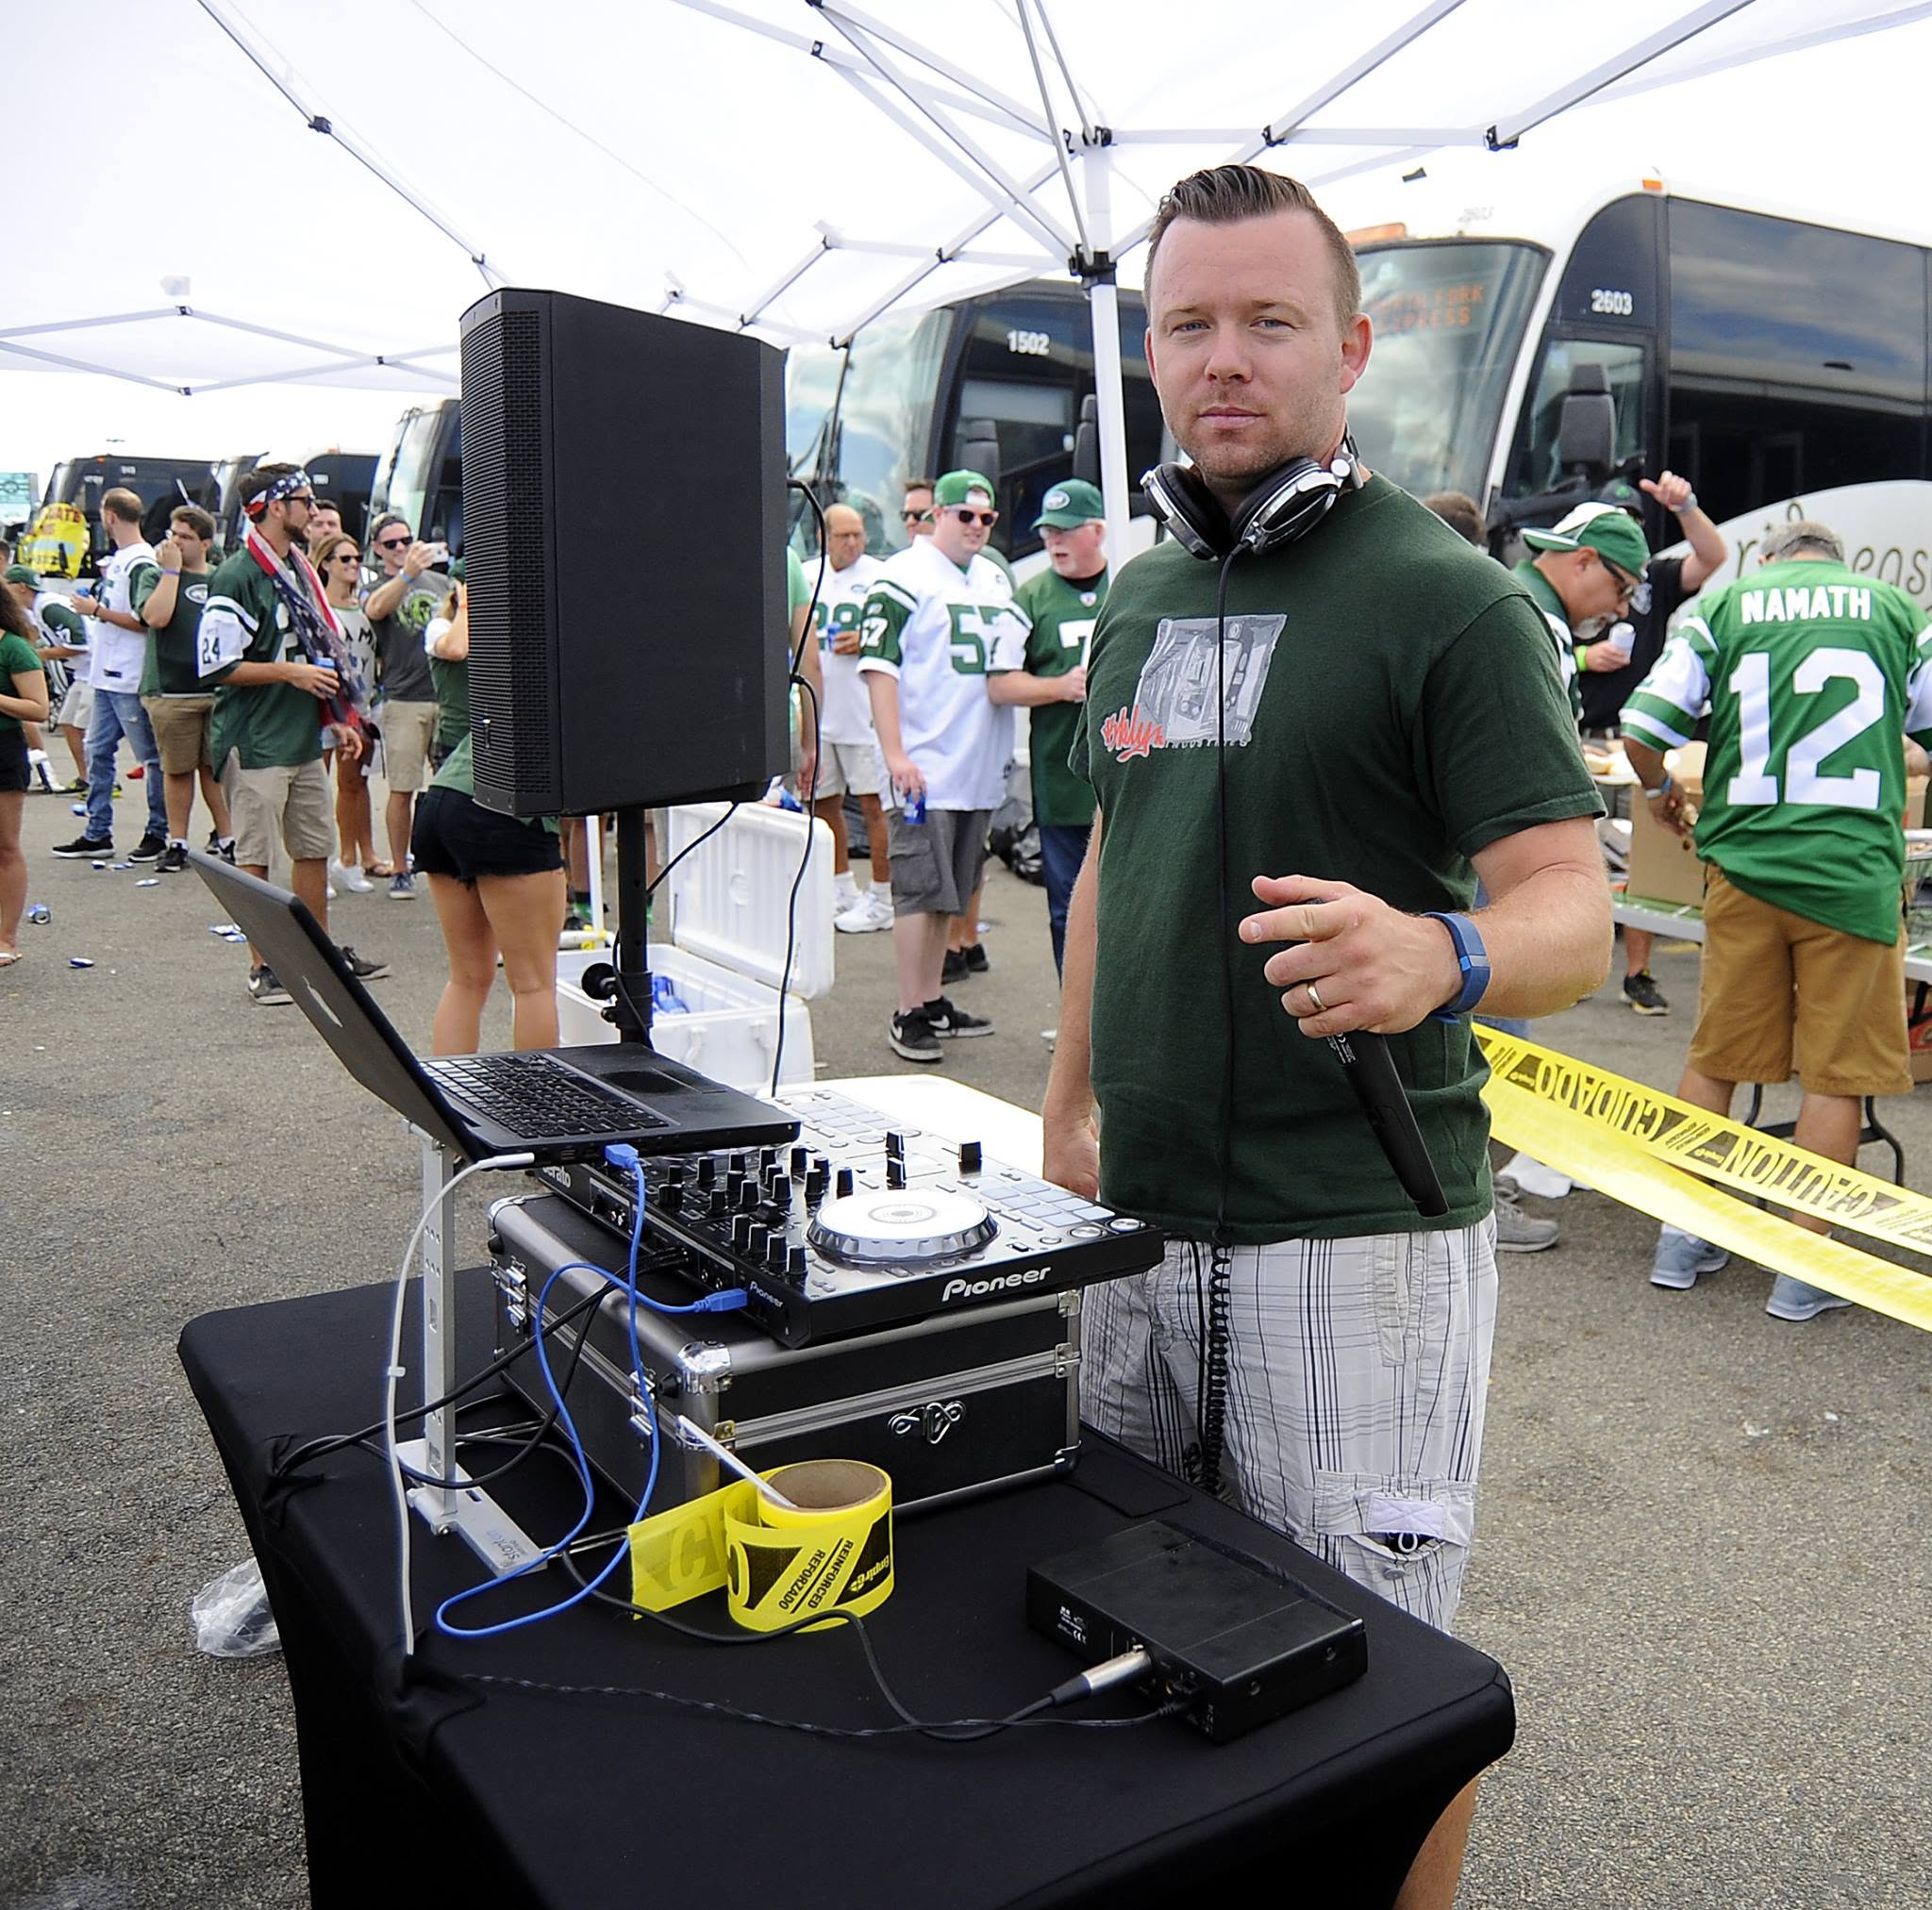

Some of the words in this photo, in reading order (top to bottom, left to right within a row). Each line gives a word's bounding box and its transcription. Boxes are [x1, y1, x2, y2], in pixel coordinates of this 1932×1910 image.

[1591, 289, 1633, 315] 2603
[1007, 329, 1050, 356] 1502
[1740, 585, 1872, 624] NAMATH
[202, 637, 220, 664] 24
[1726, 647, 1886, 810] 12
[1536, 1058, 1665, 1141] CUIDADO
[1721, 1138, 1877, 1219] CAUTION
[750, 1281, 784, 1308] Pioneer
[941, 1267, 1052, 1303] Pioneer
[778, 1549, 826, 1610] REFORZADO
[808, 1539, 854, 1609] REINFORCED
